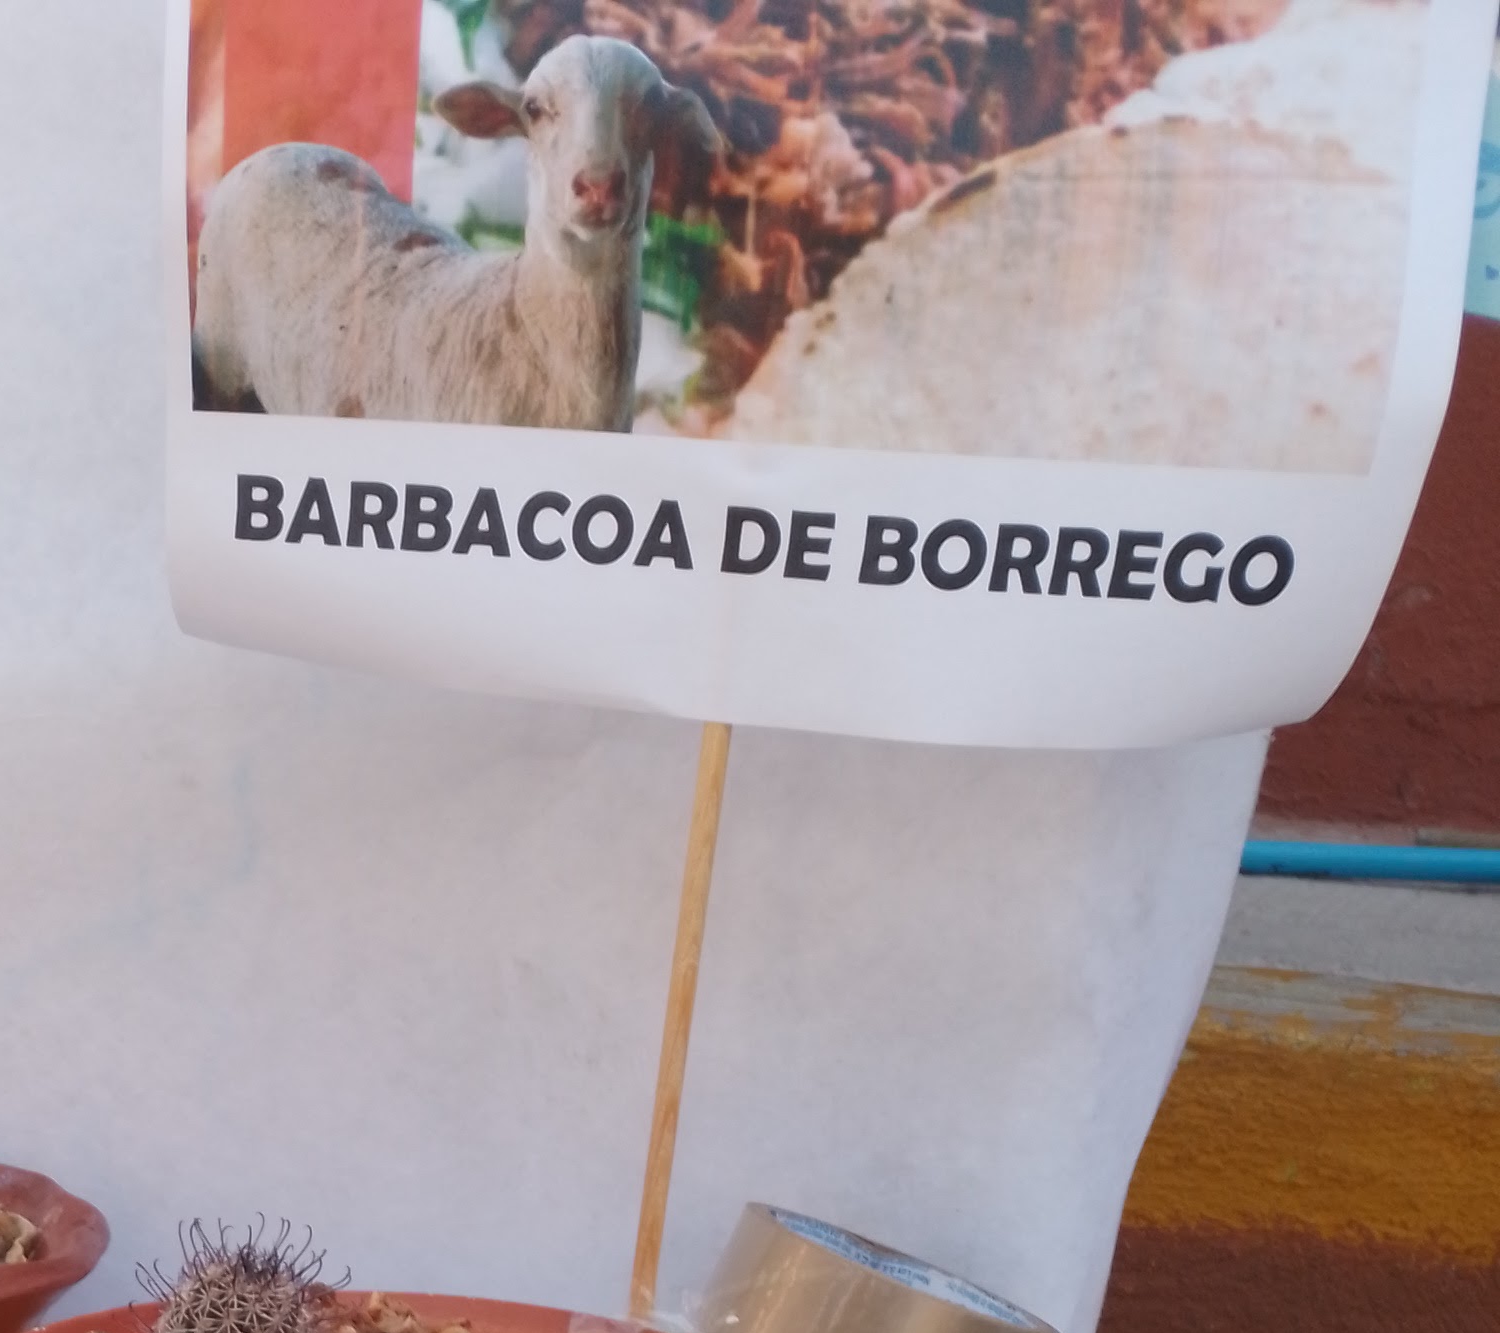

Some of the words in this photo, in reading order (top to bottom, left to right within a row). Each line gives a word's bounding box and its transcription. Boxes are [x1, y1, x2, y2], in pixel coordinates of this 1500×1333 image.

[232, 472, 694, 571] BARBACOA
[719, 504, 833, 582] DE
[856, 514, 1296, 607] BORREGO
